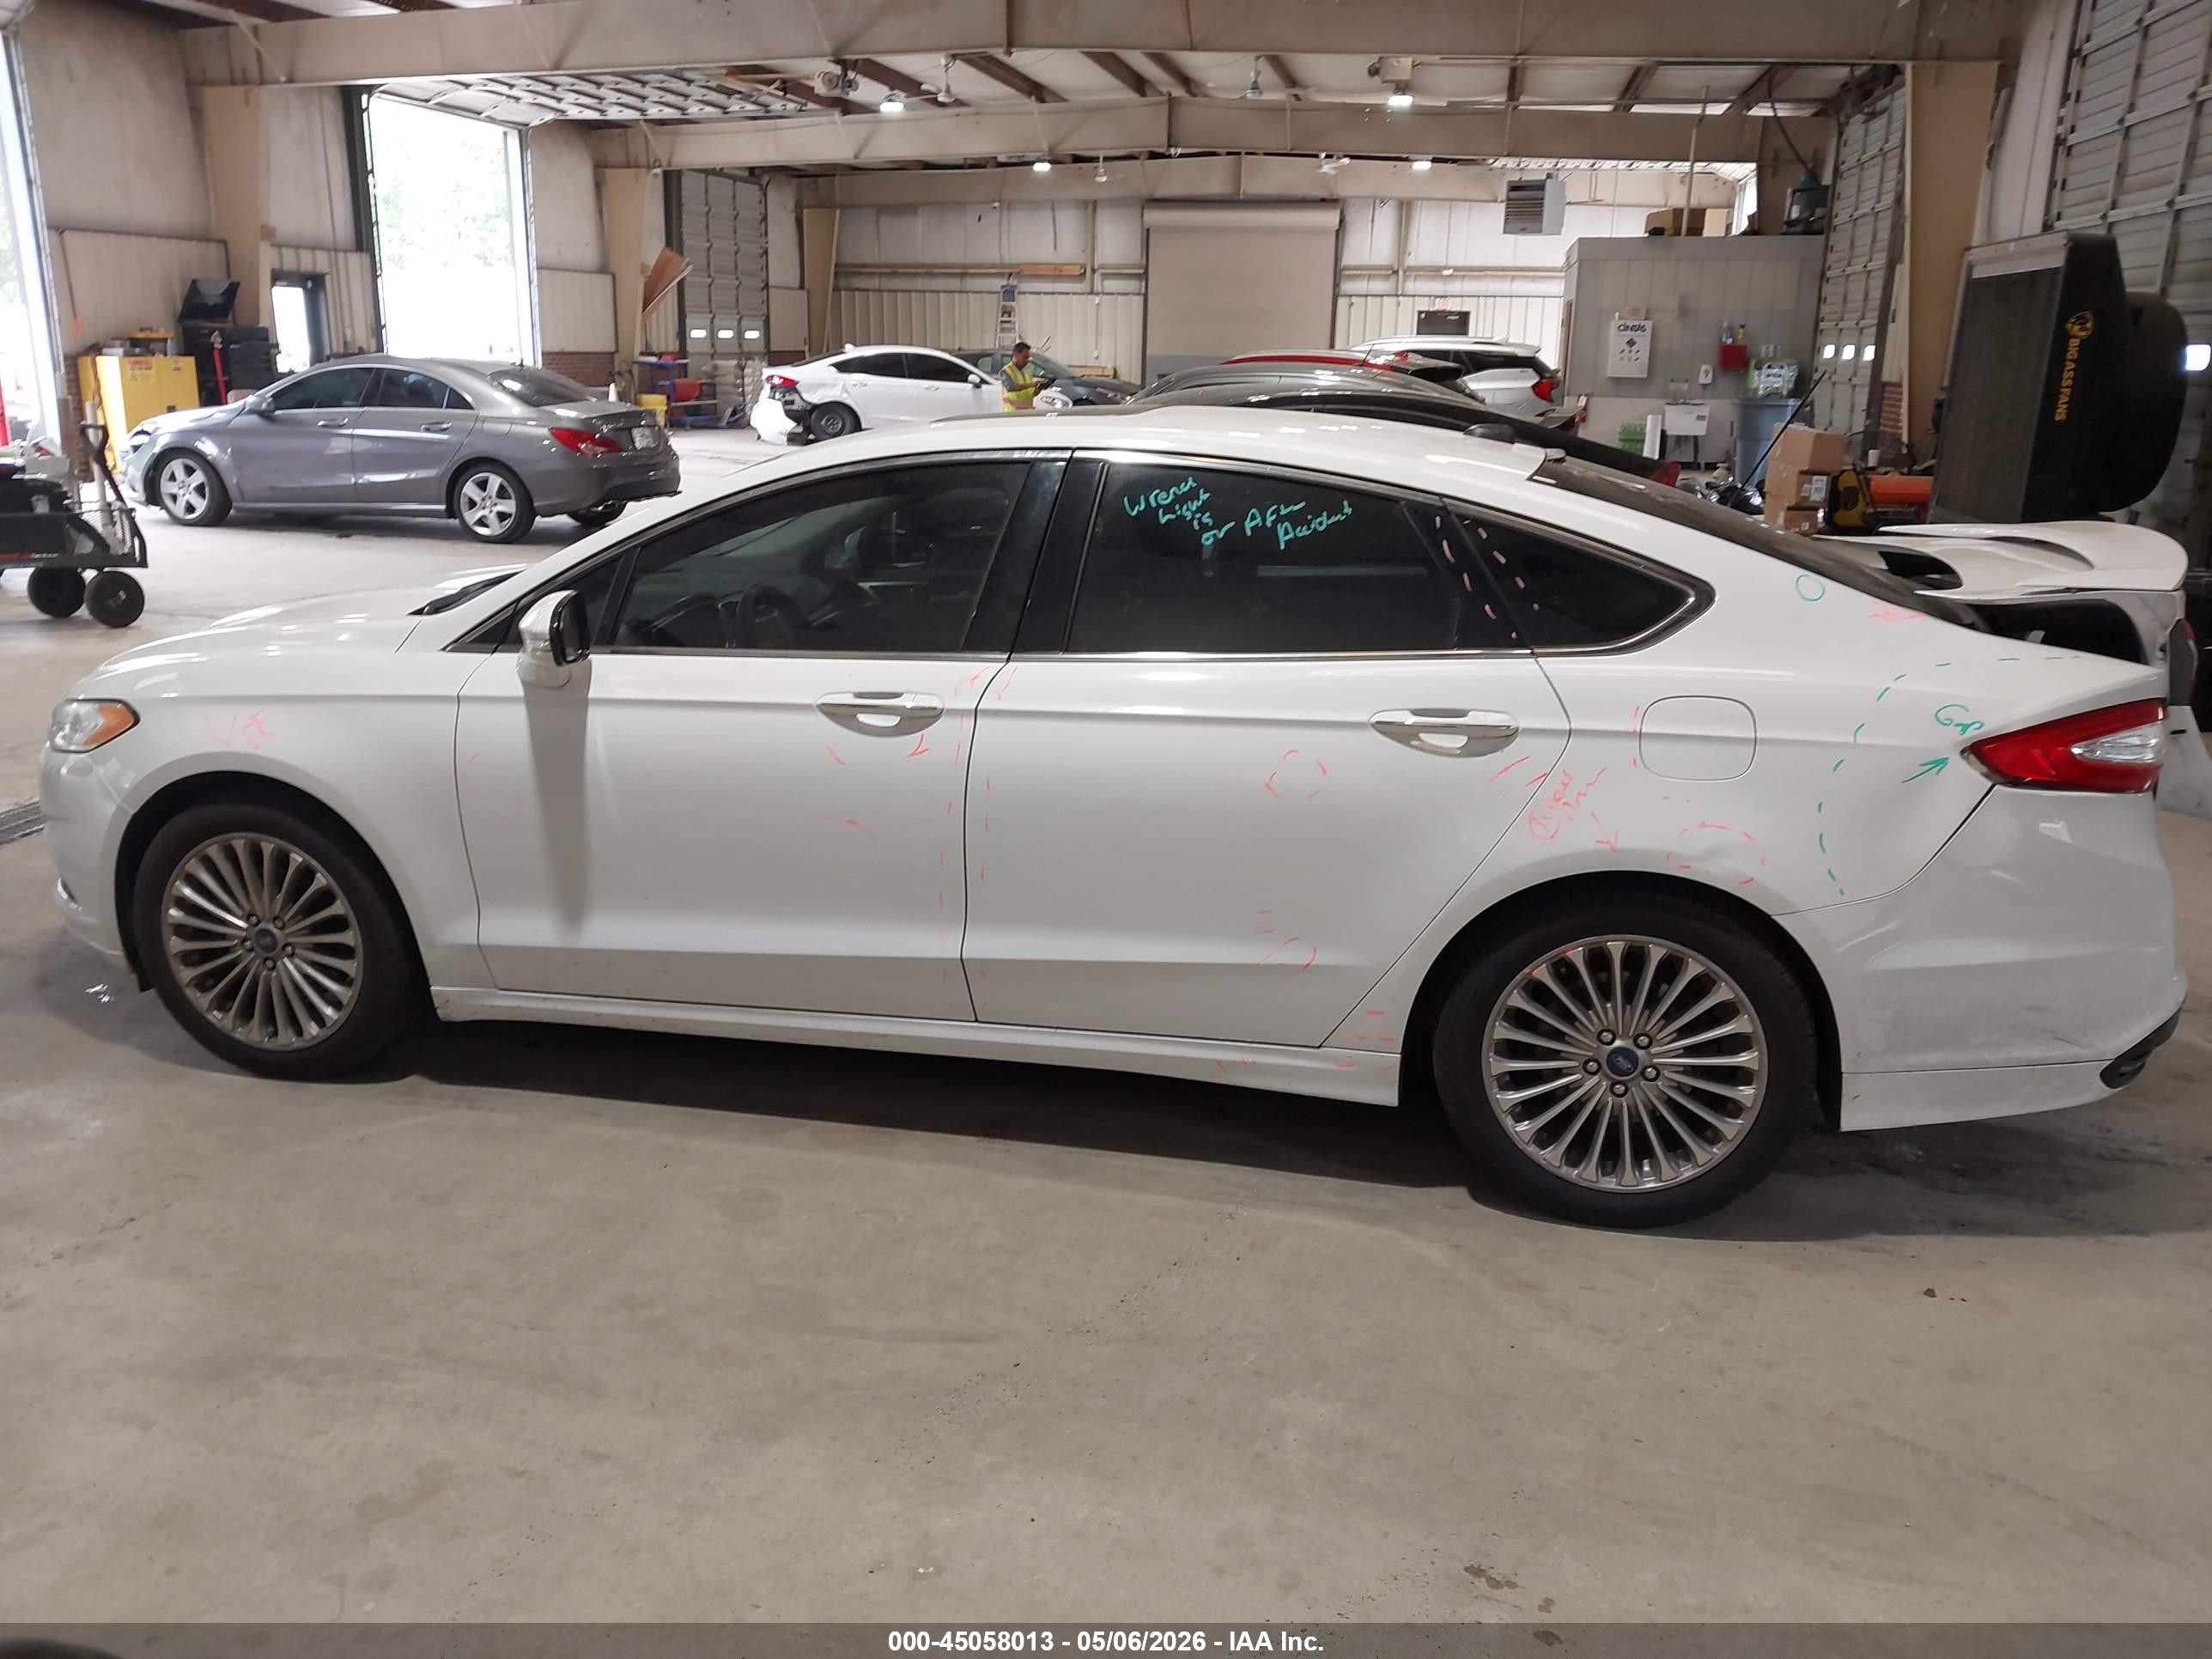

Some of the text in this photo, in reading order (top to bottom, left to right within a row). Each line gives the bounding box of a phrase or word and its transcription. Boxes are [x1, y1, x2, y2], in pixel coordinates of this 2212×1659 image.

[2055, 338, 2080, 421] BIG ASS FANS
